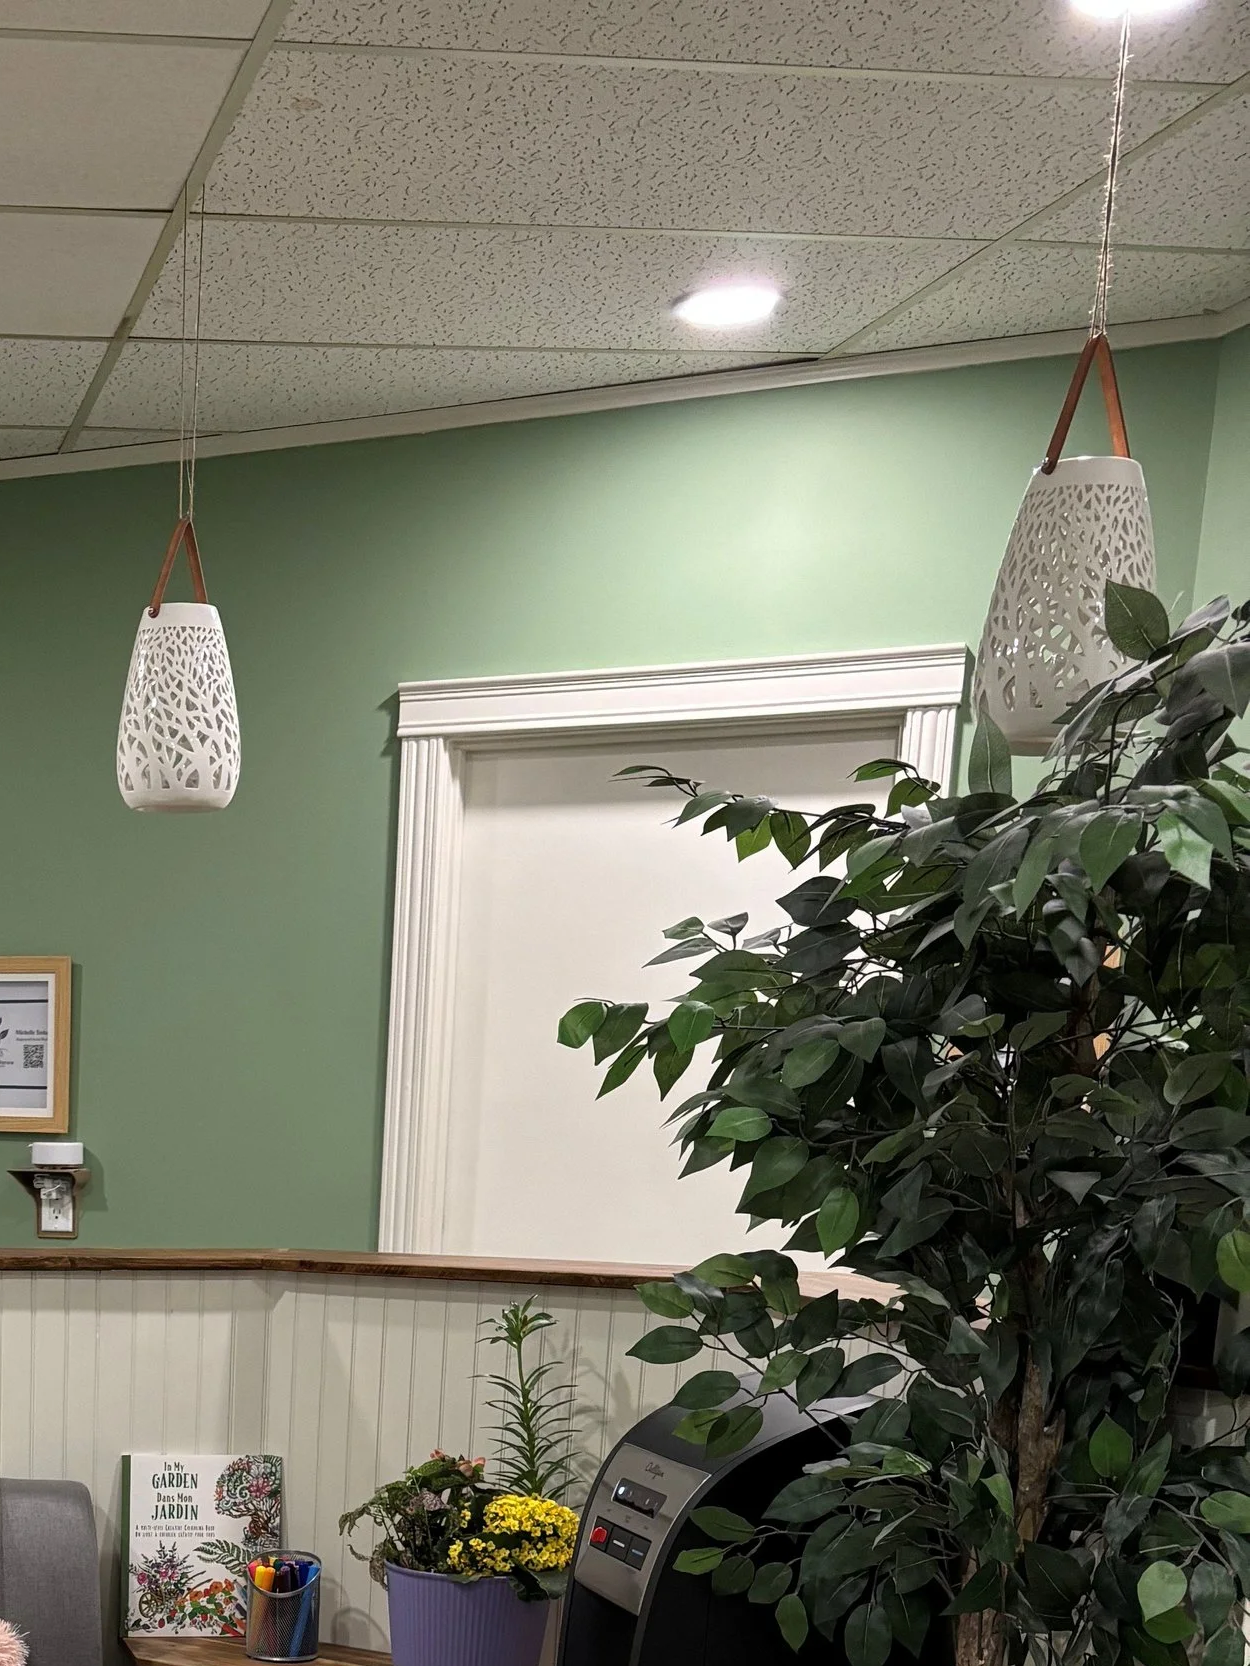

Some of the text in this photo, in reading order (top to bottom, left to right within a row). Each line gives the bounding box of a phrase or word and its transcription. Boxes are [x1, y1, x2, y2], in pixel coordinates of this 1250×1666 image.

[164, 1461, 185, 1473] In My
[152, 1472, 198, 1489] GARDEN
[157, 1492, 193, 1503] Dans Mon
[151, 1503, 198, 1520] JARDIN
